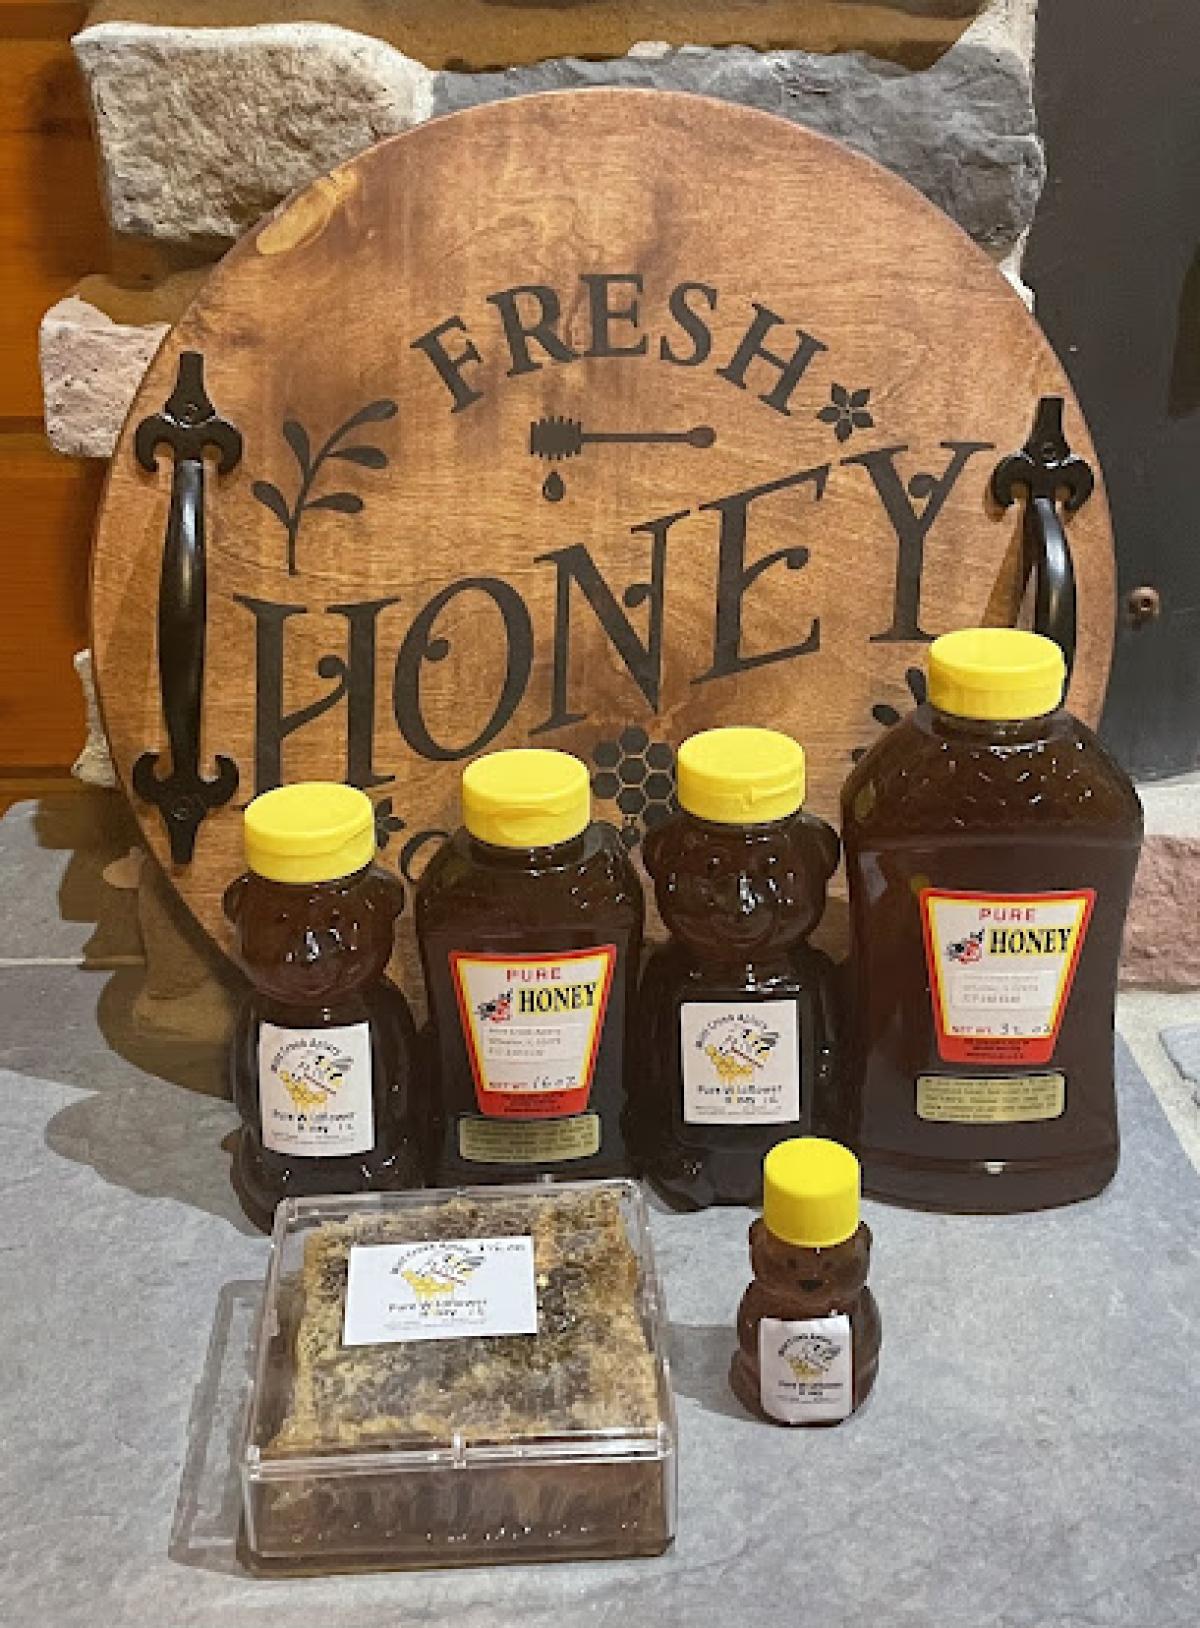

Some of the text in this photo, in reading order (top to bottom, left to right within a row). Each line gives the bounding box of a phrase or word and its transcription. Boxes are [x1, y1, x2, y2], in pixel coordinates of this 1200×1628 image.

[410, 274, 828, 416] FRESH
[233, 441, 994, 799] HONEY
[978, 908, 1036, 921] PURE
[989, 928, 1071, 954] HONEY
[506, 967, 561, 983] PURE
[518, 982, 597, 1012] HONEY
